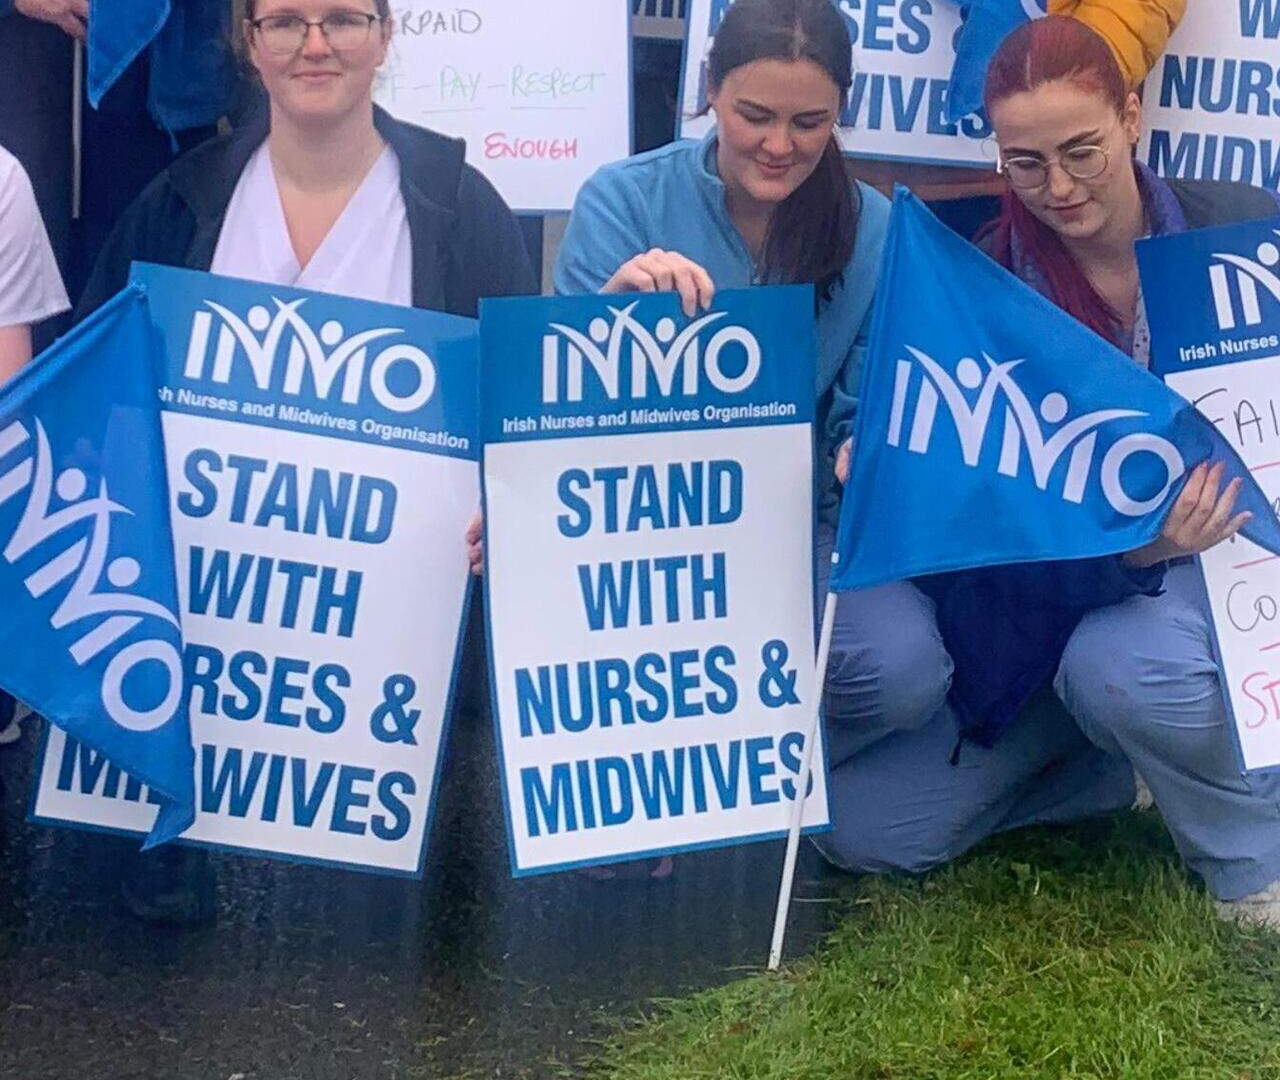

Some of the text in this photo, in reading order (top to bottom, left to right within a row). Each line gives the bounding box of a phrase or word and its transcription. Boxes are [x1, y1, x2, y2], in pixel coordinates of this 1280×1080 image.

[484, 132, 578, 159] ENOUGH
[183, 295, 436, 413] INMO
[542, 300, 761, 403] INMO
[1179, 341, 1216, 362] Irish
[1220, 333, 1278, 356] Nurses
[177, 388, 238, 413] Nurses
[241, 401, 275, 419] and
[278, 405, 357, 433] Midwives
[361, 418, 469, 450] Organisation
[503, 400, 796, 433] Irish Nurses and Midwives Organisation
[887, 344, 1184, 517] INMO
[177, 448, 398, 545] STAND
[557, 459, 743, 539] STAND
[187, 545, 363, 639] WITH
[578, 552, 728, 632] WITH
[185, 642, 421, 746] RSES &
[515, 639, 801, 738] NURSES &
[57, 731, 416, 841] MWIVES
[520, 731, 813, 838] MIDWIVES
